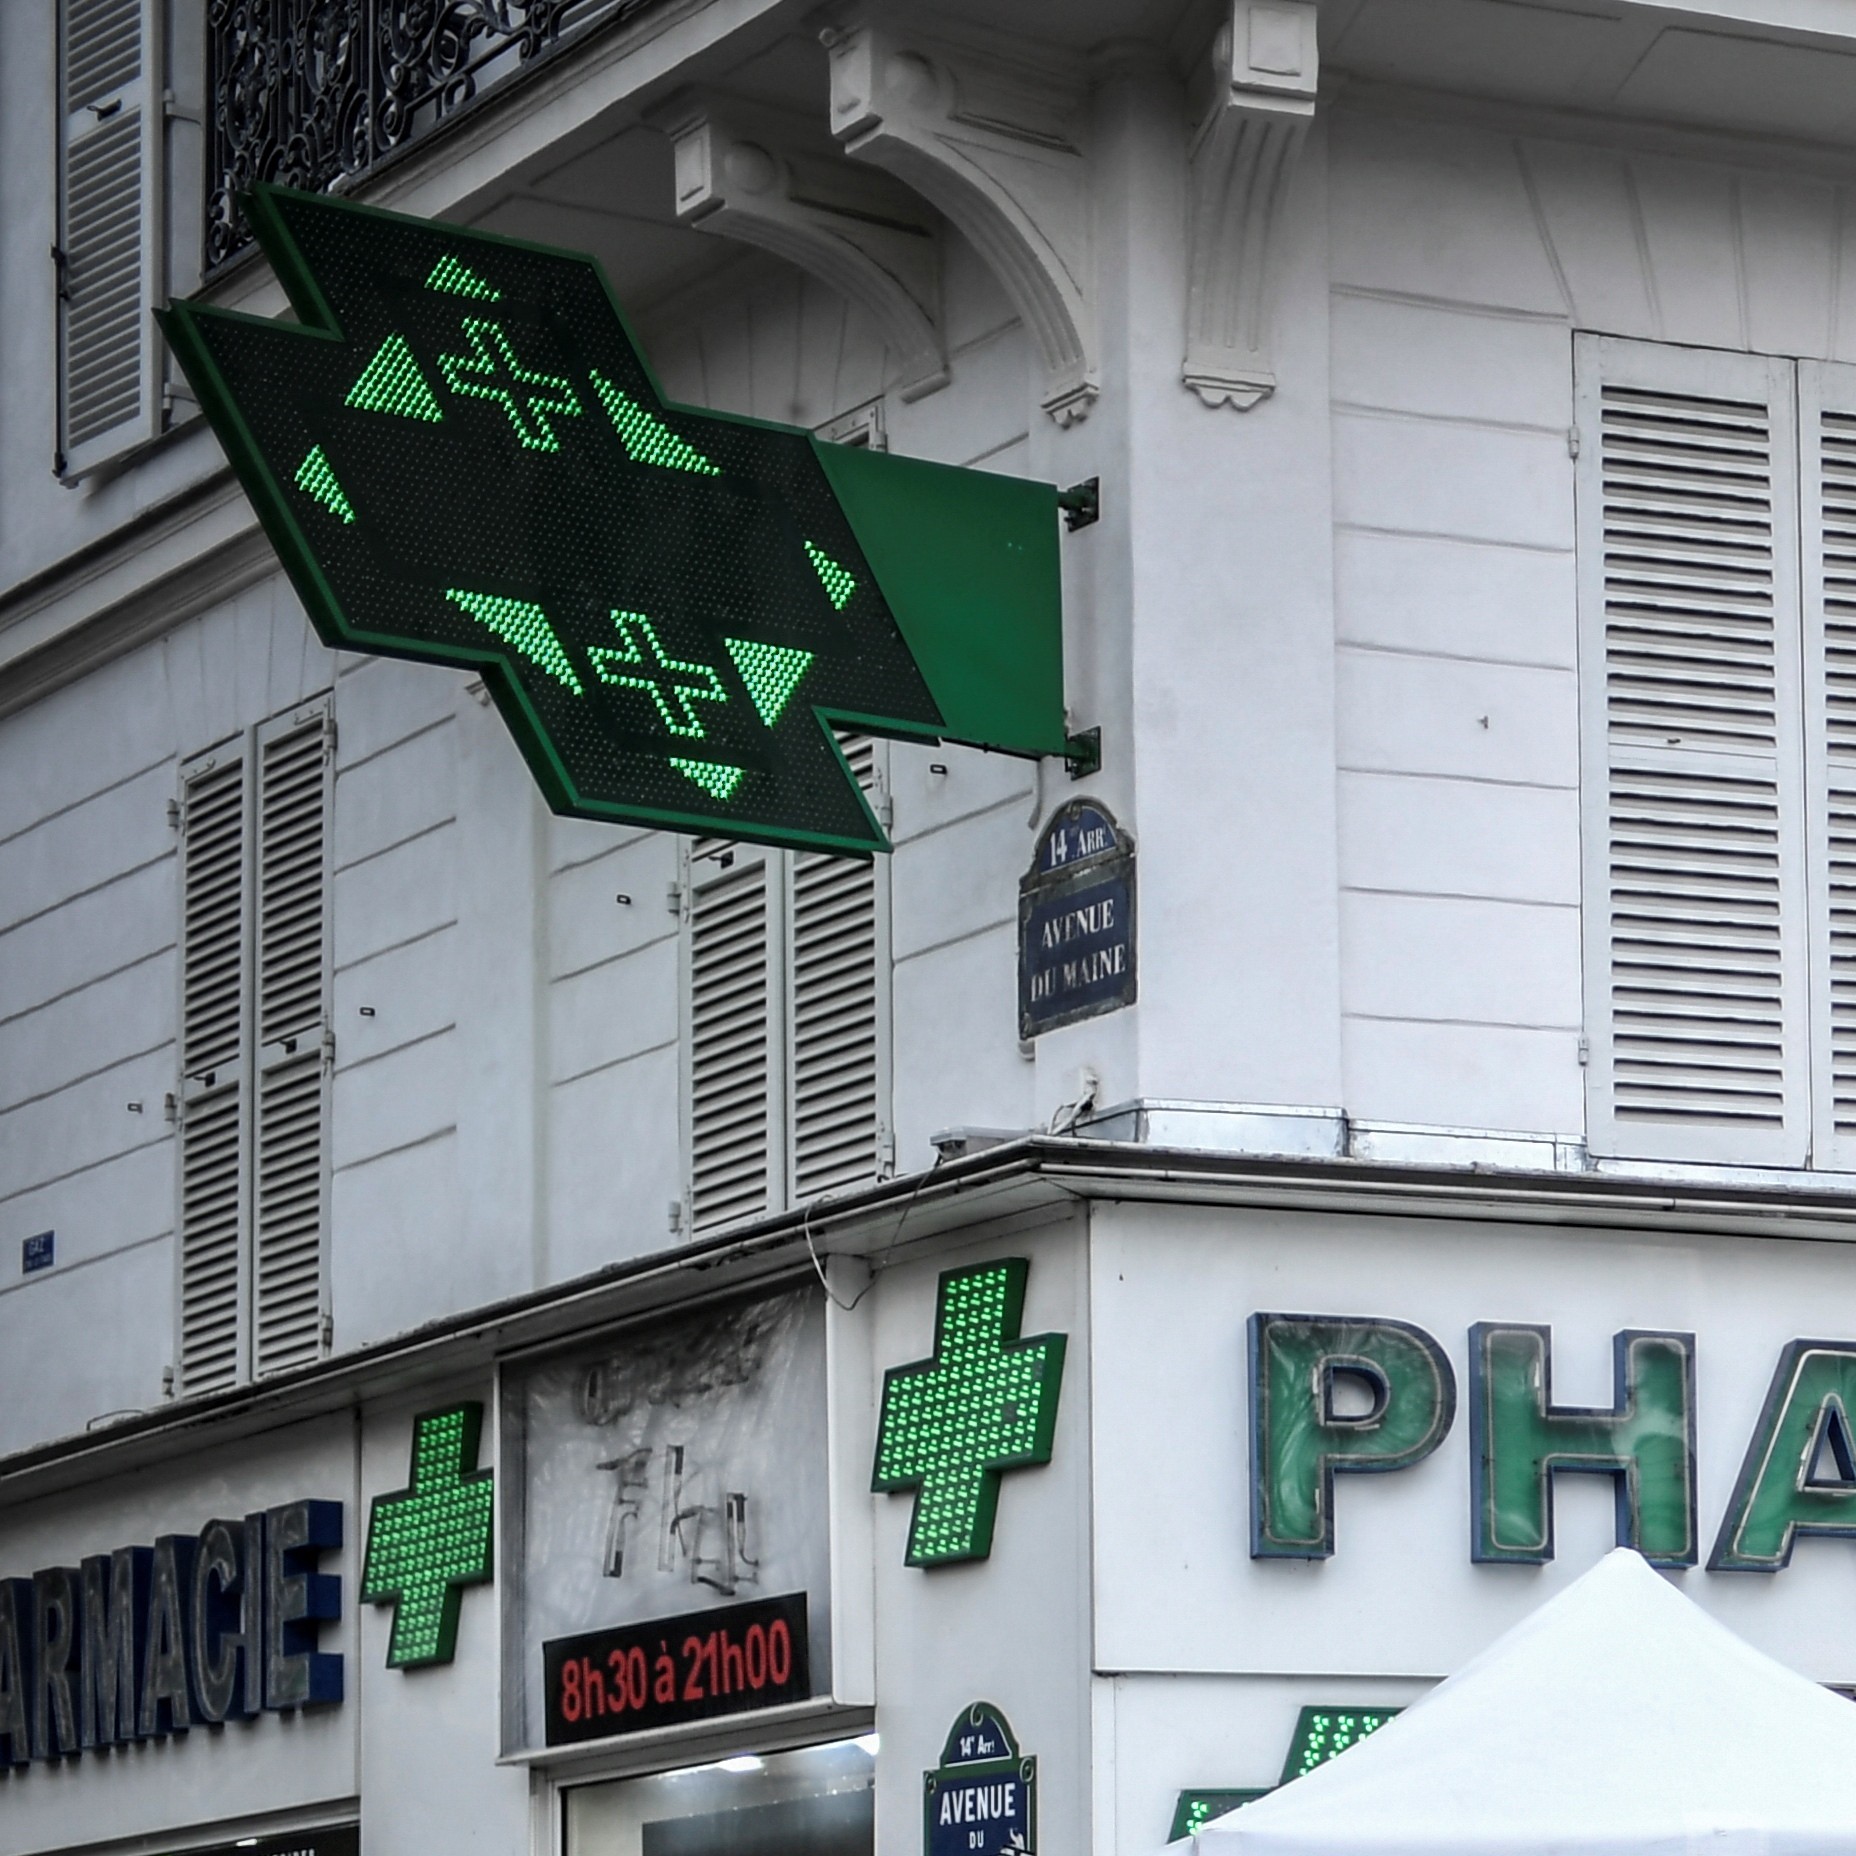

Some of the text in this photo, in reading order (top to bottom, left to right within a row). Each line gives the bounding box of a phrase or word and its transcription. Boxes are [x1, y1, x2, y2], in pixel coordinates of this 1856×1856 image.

[1041, 899, 1115, 948] AVENUE
[1030, 944, 1126, 1002] DU MAINE
[561, 1619, 791, 1722] 8h30 à 21h00
[939, 1782, 1016, 1826] AVENUE
[969, 1830, 984, 1849] DU
